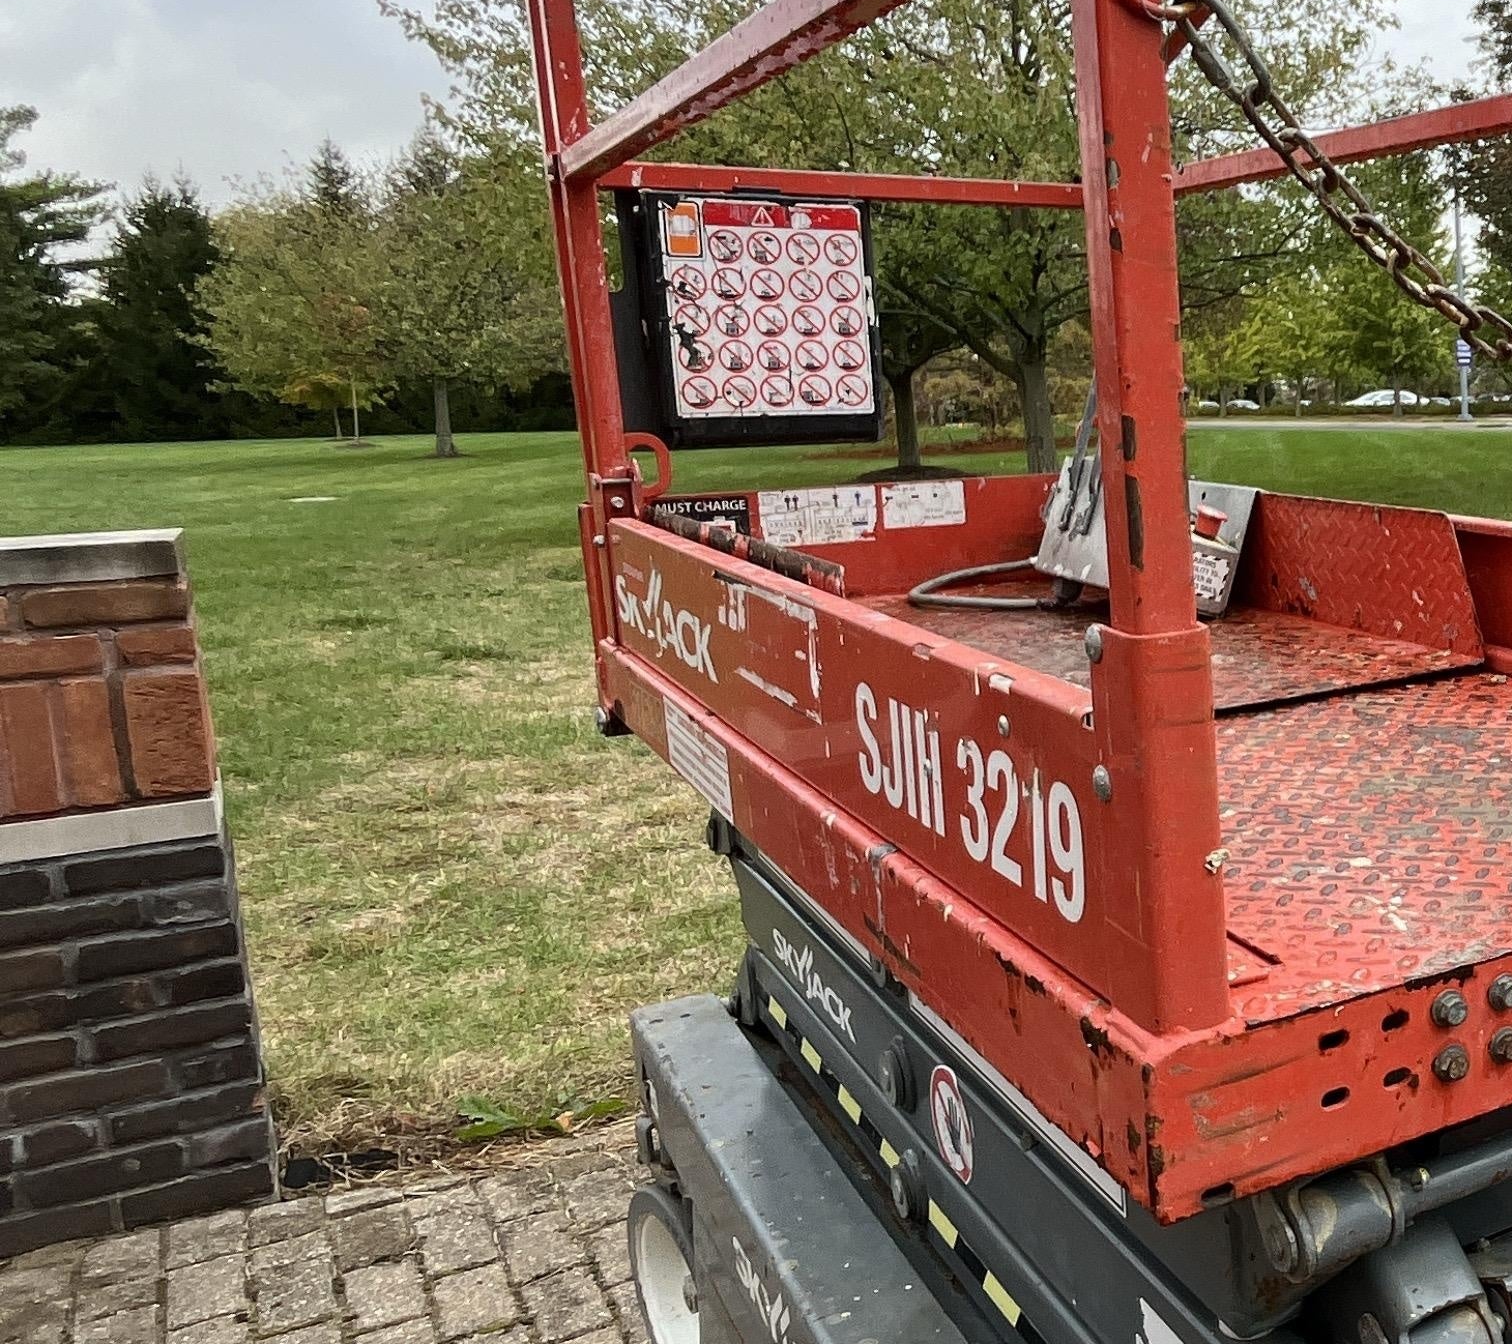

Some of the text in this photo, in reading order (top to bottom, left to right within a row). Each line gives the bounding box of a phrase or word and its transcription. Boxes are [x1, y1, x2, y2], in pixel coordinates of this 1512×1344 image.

[655, 499, 747, 514] MUST CHARGE
[956, 738, 1086, 924] 3219
[772, 927, 857, 1045] SKYJACK
